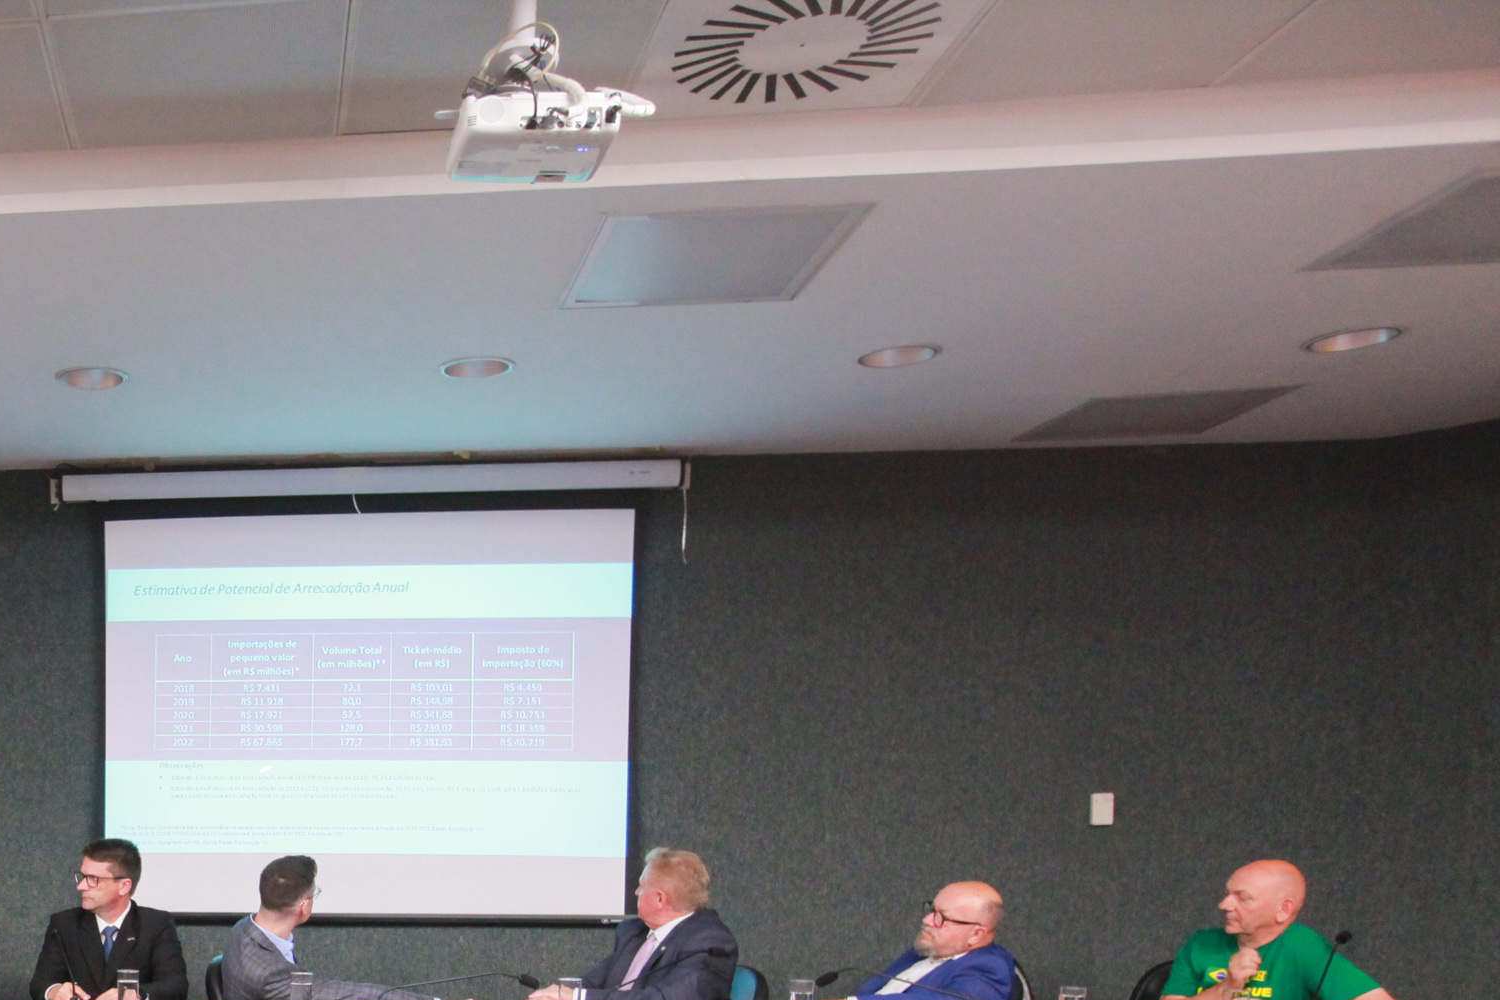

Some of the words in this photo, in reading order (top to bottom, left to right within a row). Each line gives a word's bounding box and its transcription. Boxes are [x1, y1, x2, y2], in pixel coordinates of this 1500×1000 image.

[134, 584, 197, 596] Estimativa
[200, 584, 215, 595] de
[217, 584, 273, 595] Potencial
[275, 583, 290, 594] de
[292, 583, 369, 595] Arrecadação
[372, 582, 409, 593] Anual
[227, 640, 284, 650] Importações
[286, 640, 297, 648] de
[322, 646, 357, 655] Volume
[359, 646, 382, 654] Total
[402, 646, 462, 654] Ticket-médio
[497, 646, 536, 655] Imposto
[230, 654, 270, 662] pequeno
[272, 654, 294, 662] valor
[317, 660, 335, 668] (em
[414, 660, 433, 668] (em
[434, 659, 450, 668] R$)
[482, 660, 536, 669] Importação
[537, 659, 564, 668] (60%)
[223, 668, 241, 676] (em
[243, 667, 256, 675] R$
[173, 685, 194, 693] 2018
[243, 684, 256, 693] R$
[257, 684, 280, 693] 7.431
[342, 684, 361, 692] 72,1
[425, 684, 453, 692] 103,01
[241, 698, 253, 706] R$
[342, 698, 362, 706] 80,0
[410, 697, 422, 705] R$
[425, 697, 453, 706] 148,98
[173, 711, 194, 720] 2020
[240, 711, 252, 720] R$
[342, 711, 361, 719] 52,5
[410, 711, 422, 719] R$
[423, 711, 453, 719] 341,68
[173, 725, 193, 733] 2021
[240, 725, 252, 733] R$
[340, 724, 363, 733] 128,0
[410, 725, 422, 733] R$
[423, 725, 452, 733] 239,07
[500, 724, 512, 732] R$
[515, 724, 545, 732] 18.359
[173, 738, 193, 746] 2022
[240, 739, 252, 747] R$
[252, 738, 283, 746] 67.865
[340, 738, 363, 747] 177,7
[410, 738, 422, 747] R$
[423, 738, 452, 747] 381,93
[500, 738, 512, 747] R$
[514, 738, 545, 747] 40.719
